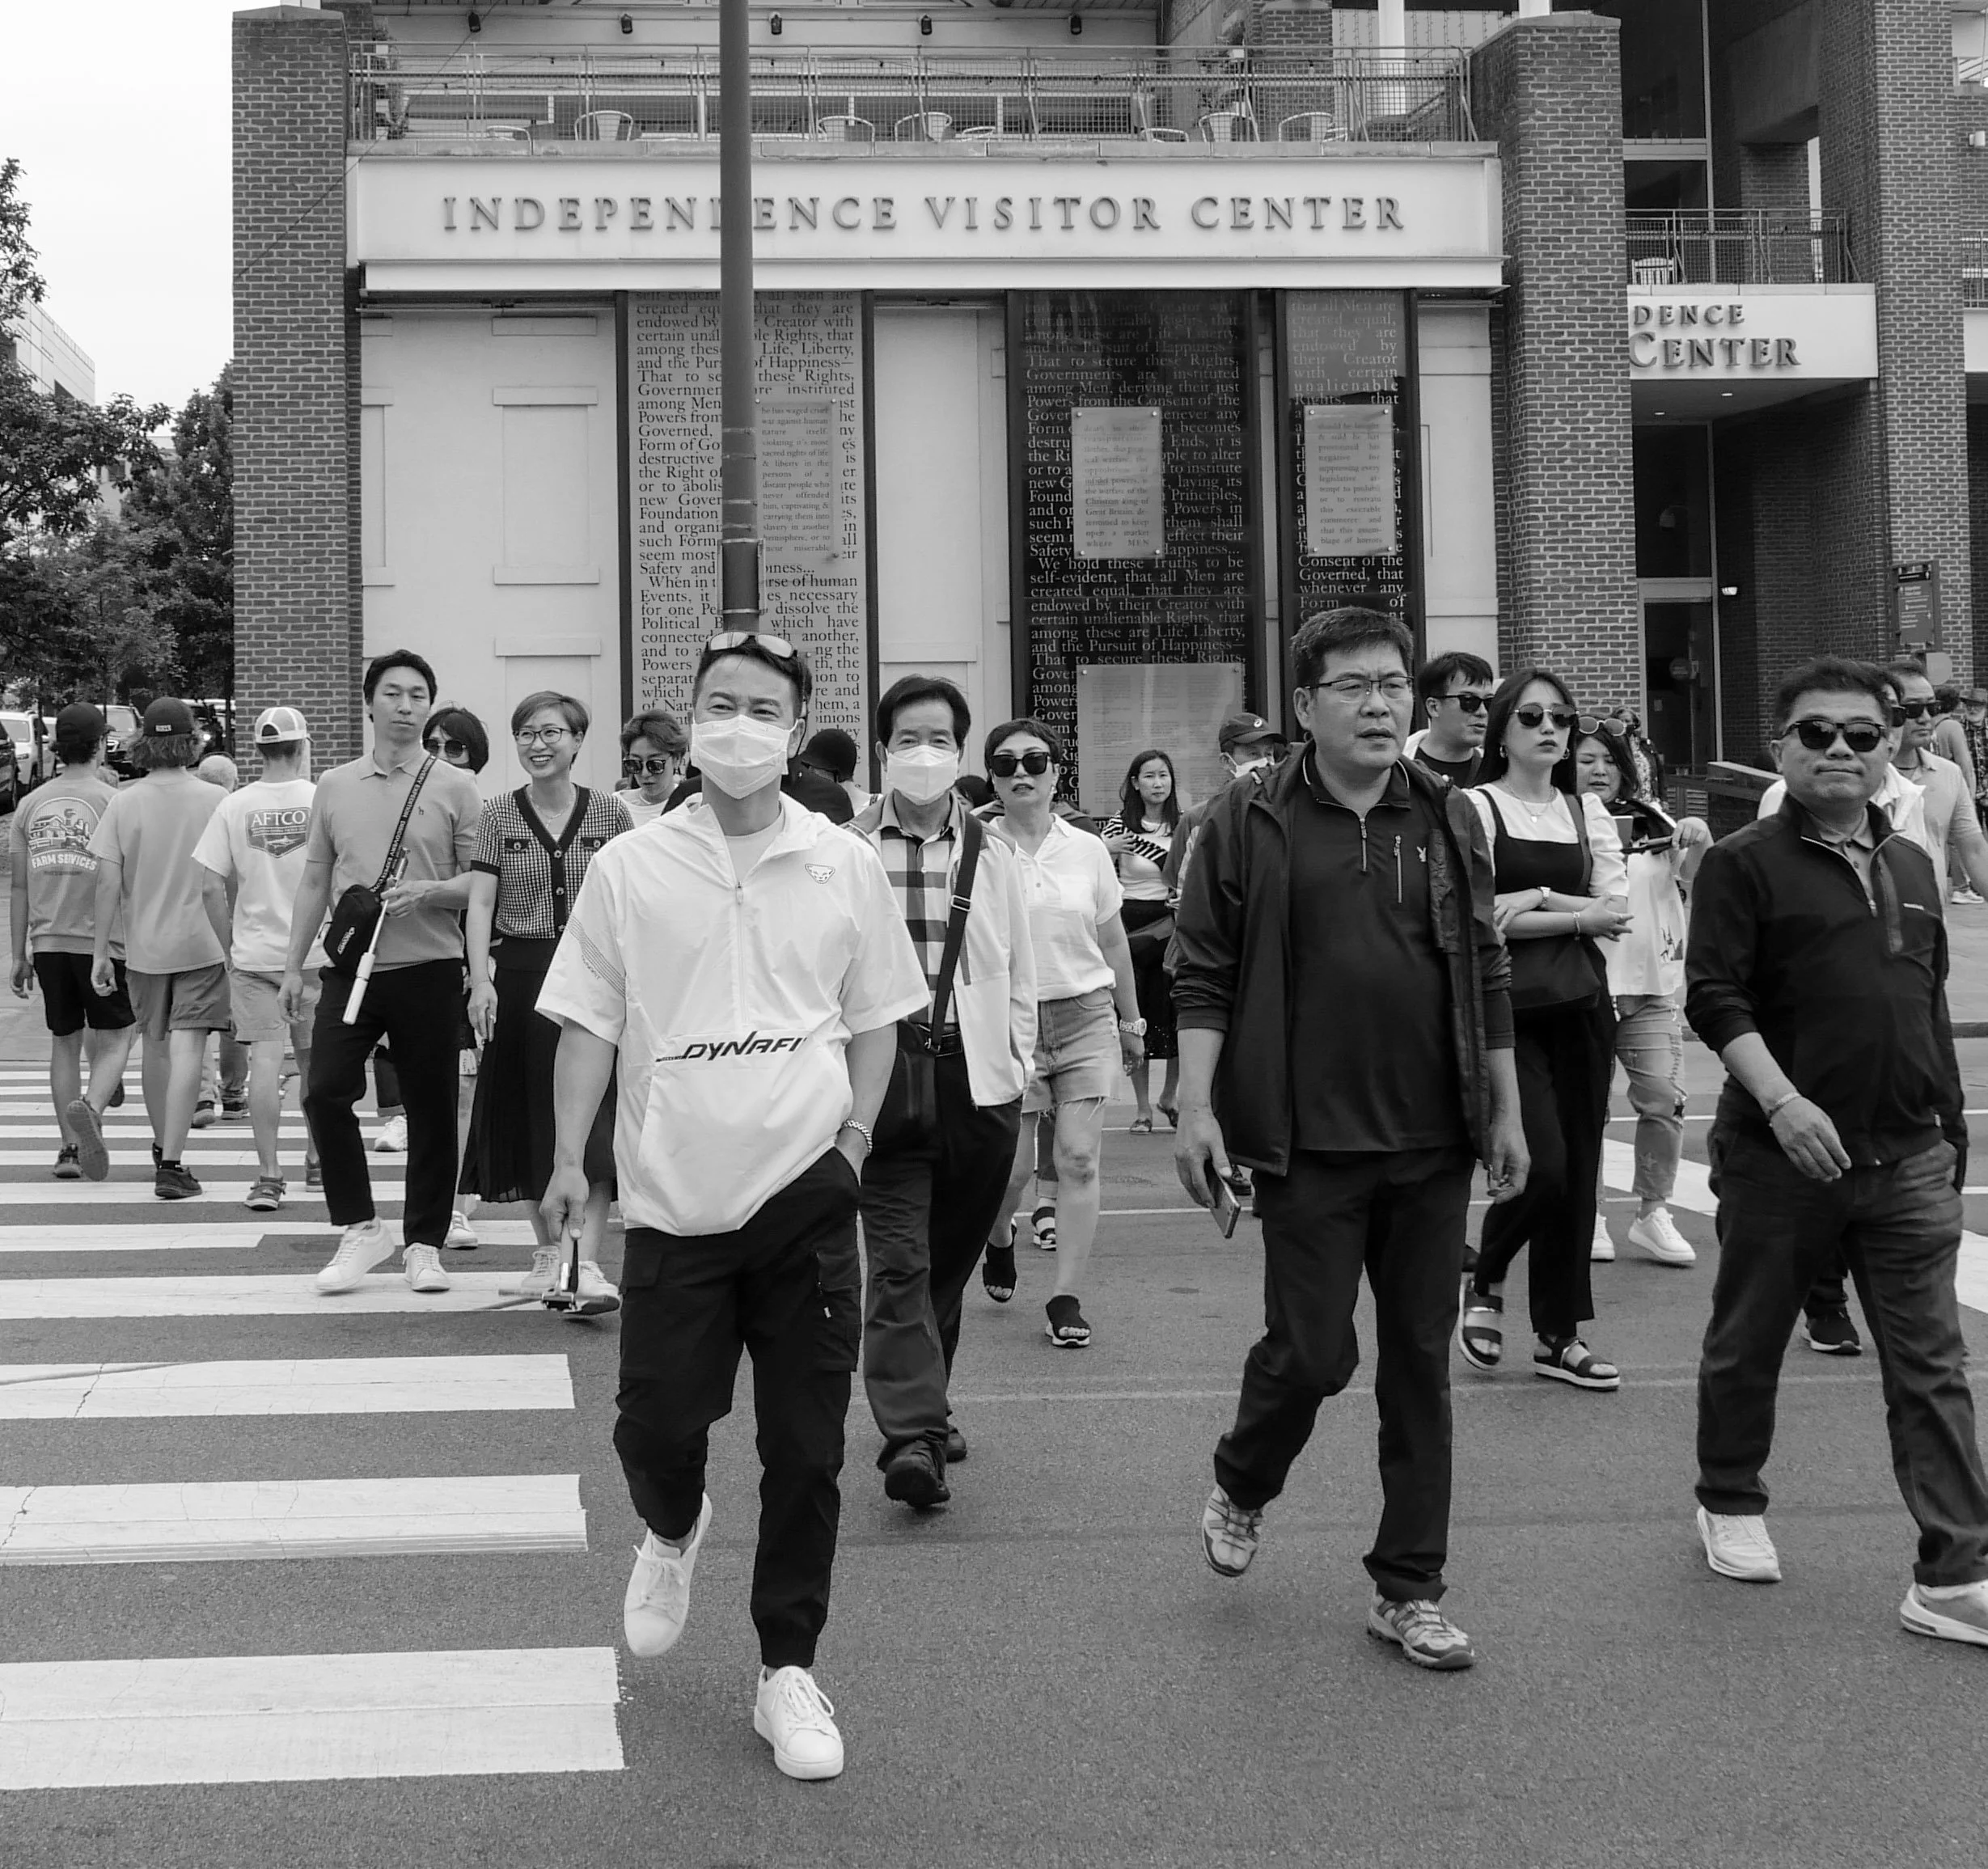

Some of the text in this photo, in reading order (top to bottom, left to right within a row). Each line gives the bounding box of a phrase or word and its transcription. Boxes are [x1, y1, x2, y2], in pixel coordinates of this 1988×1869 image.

[924, 196, 1161, 230] VISITOR
[1191, 196, 1405, 231] CENTER
[1633, 304, 1745, 325] DENCE
[637, 315, 854, 332] endowed by Creator with
[637, 328, 854, 345] certain Rights, that
[637, 342, 854, 359] among Life, Liberty,
[1629, 331, 1802, 368] CENTER
[637, 355, 662, 369] and
[668, 355, 689, 369] the
[637, 370, 673, 383] That
[686, 372, 699, 383] to
[759, 370, 796, 383] these
[1026, 385, 1074, 398] among
[1118, 380, 1173, 397] deriving
[1179, 380, 1210, 393] their
[1216, 380, 1239, 397] just
[637, 400, 686, 413] among
[1027, 393, 1241, 408] Powers from the Consent of the
[639, 410, 686, 423] Powers
[637, 424, 713, 438] Governed,
[639, 438, 697, 451] Form of
[639, 451, 715, 465] destructive
[639, 465, 705, 482] the Right
[639, 481, 676, 493] or to
[639, 497, 668, 506] new
[1174, 501, 1242, 514] Powers in
[639, 506, 718, 519] Foundation
[639, 520, 665, 534] and
[1210, 514, 1242, 527] shall
[639, 534, 673, 547] such
[639, 550, 717, 560] seem most
[1030, 543, 1072, 560] Safety
[1038, 556, 1061, 569] We
[1068, 556, 1100, 569] hold
[1108, 556, 1144, 569] these
[1205, 557, 1220, 568] to
[1228, 555, 1244, 568] be
[639, 561, 715, 578] Safety and
[649, 575, 857, 588] When in of human
[1030, 569, 1244, 585] self-evident, that all Men are
[641, 589, 859, 606] Events, it necessary
[1030, 584, 1082, 597] created
[1145, 583, 1173, 596] that
[1184, 582, 1213, 599] they
[1223, 586, 1244, 595] are
[641, 603, 859, 615] for one dissolve the
[1030, 596, 1244, 615] endowed by their Creator with
[642, 616, 859, 629] Political which have
[1030, 611, 1077, 625] certain
[1084, 611, 1161, 624] unalienable
[1218, 610, 1246, 624] that
[802, 629, 859, 644] another,
[1030, 630, 1079, 643] among
[1085, 625, 1121, 638] these
[1129, 629, 1150, 638] are
[1194, 624, 1246, 641] Liberty,
[641, 644, 861, 657] and to the
[1032, 640, 1056, 653] and
[1061, 639, 1084, 653] the
[1089, 639, 1137, 652] Pursuit
[1142, 639, 1158, 652] of
[642, 658, 861, 670] Powers the
[1032, 653, 1066, 666] That
[1076, 654, 1089, 666] to
[1098, 656, 1142, 665] secure
[1152, 651, 1187, 665] these
[846, 673, 861, 683] to
[642, 685, 861, 698] which and
[251, 810, 307, 828] AFTCO
[32, 854, 56, 869] FARM
[678, 1030, 807, 1061] DYNAFI
